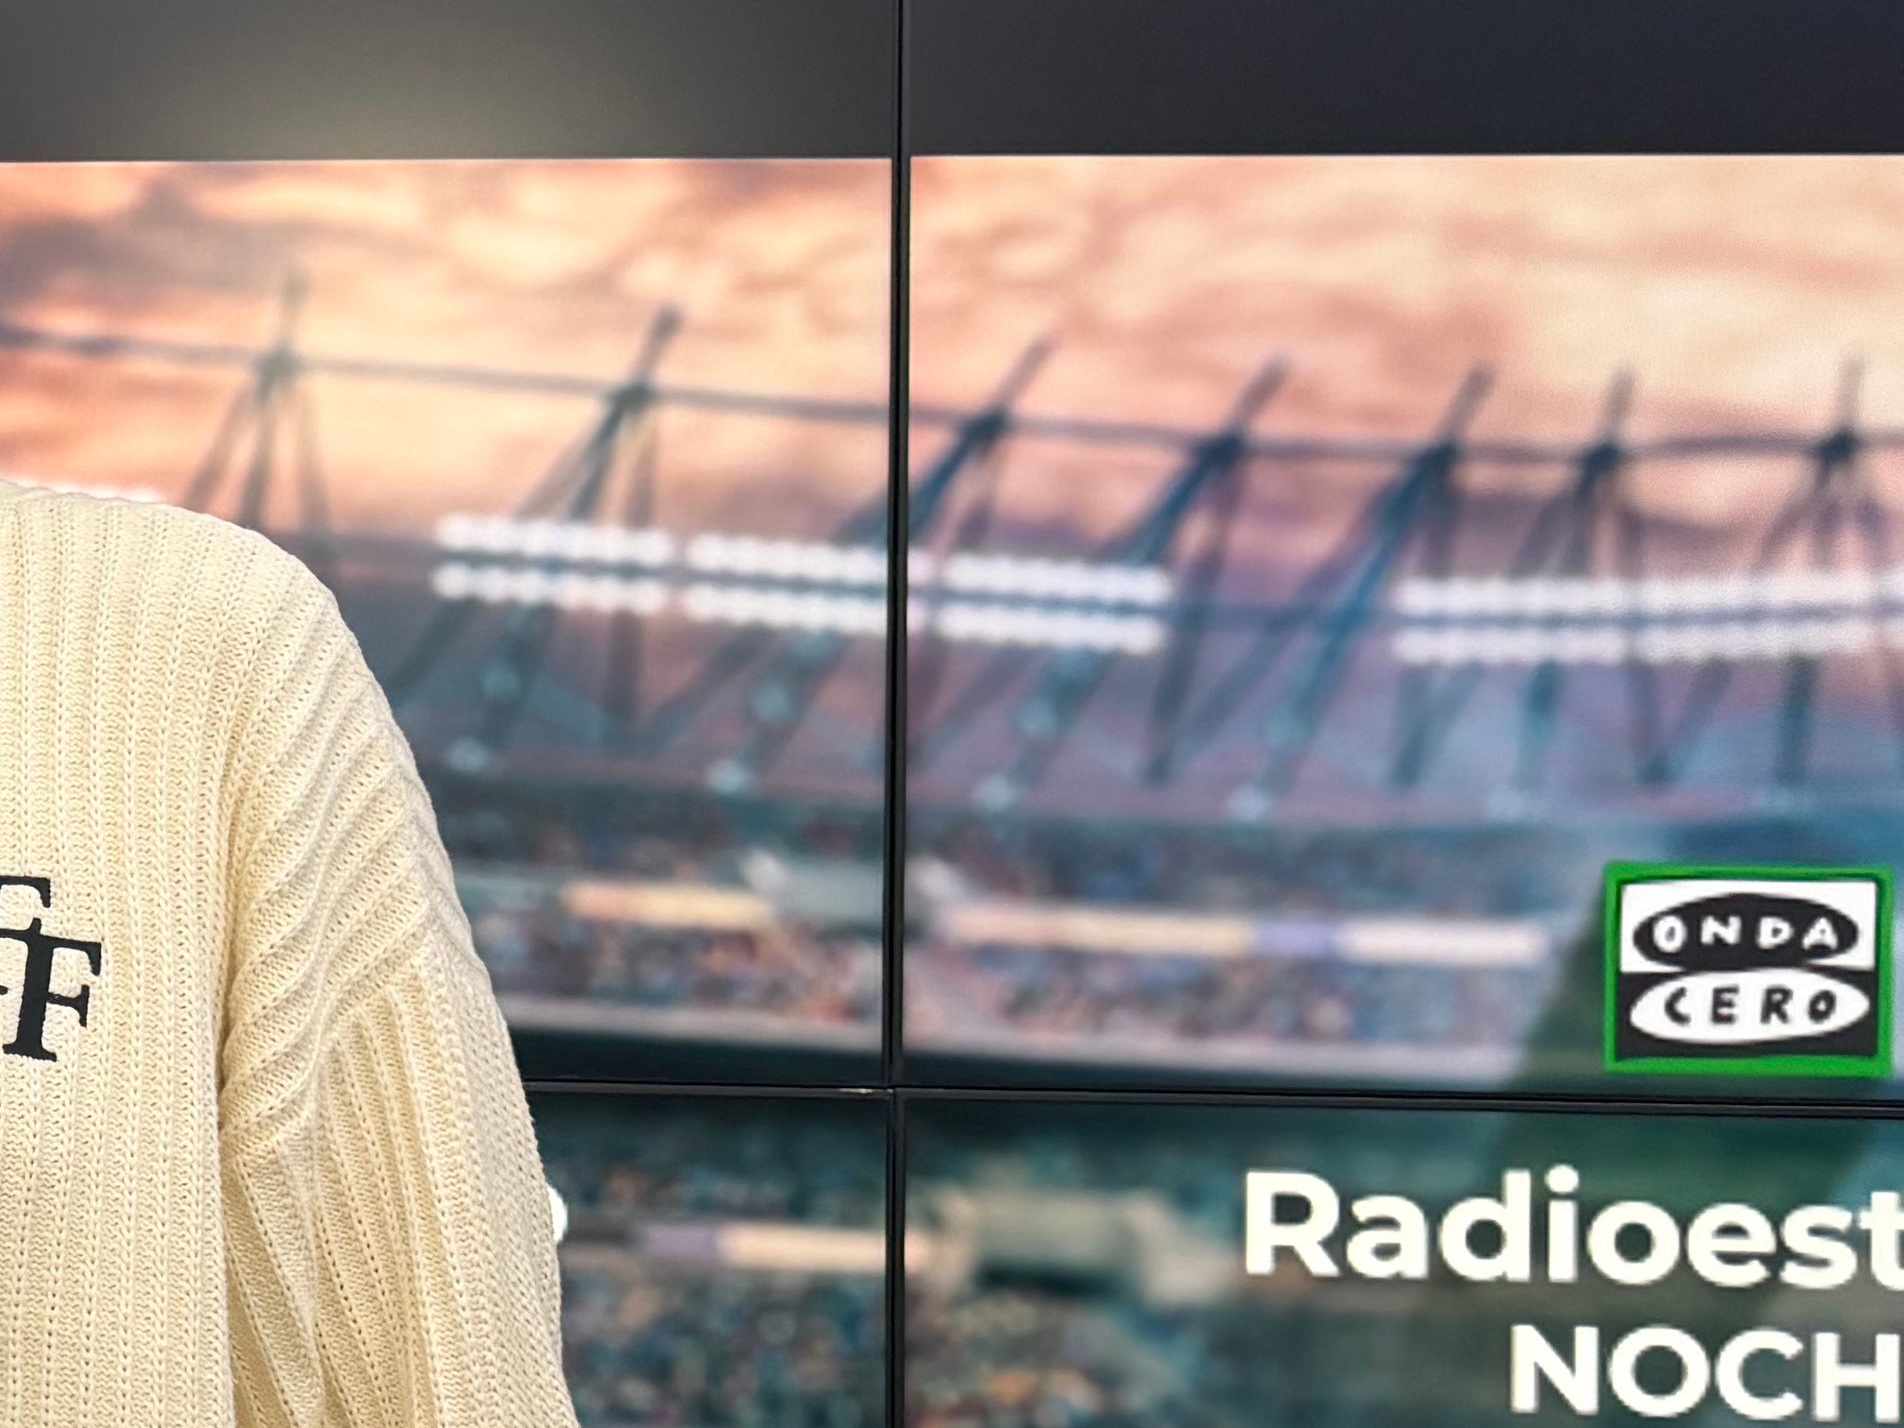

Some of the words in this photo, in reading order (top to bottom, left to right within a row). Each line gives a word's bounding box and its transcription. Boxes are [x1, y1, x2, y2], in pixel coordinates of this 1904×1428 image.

[1651, 914, 1840, 954] ONDA
[1662, 985, 1838, 1025] CERO
[1244, 1164, 1904, 1291] Radioest
[1510, 1323, 1901, 1423] NOCH
